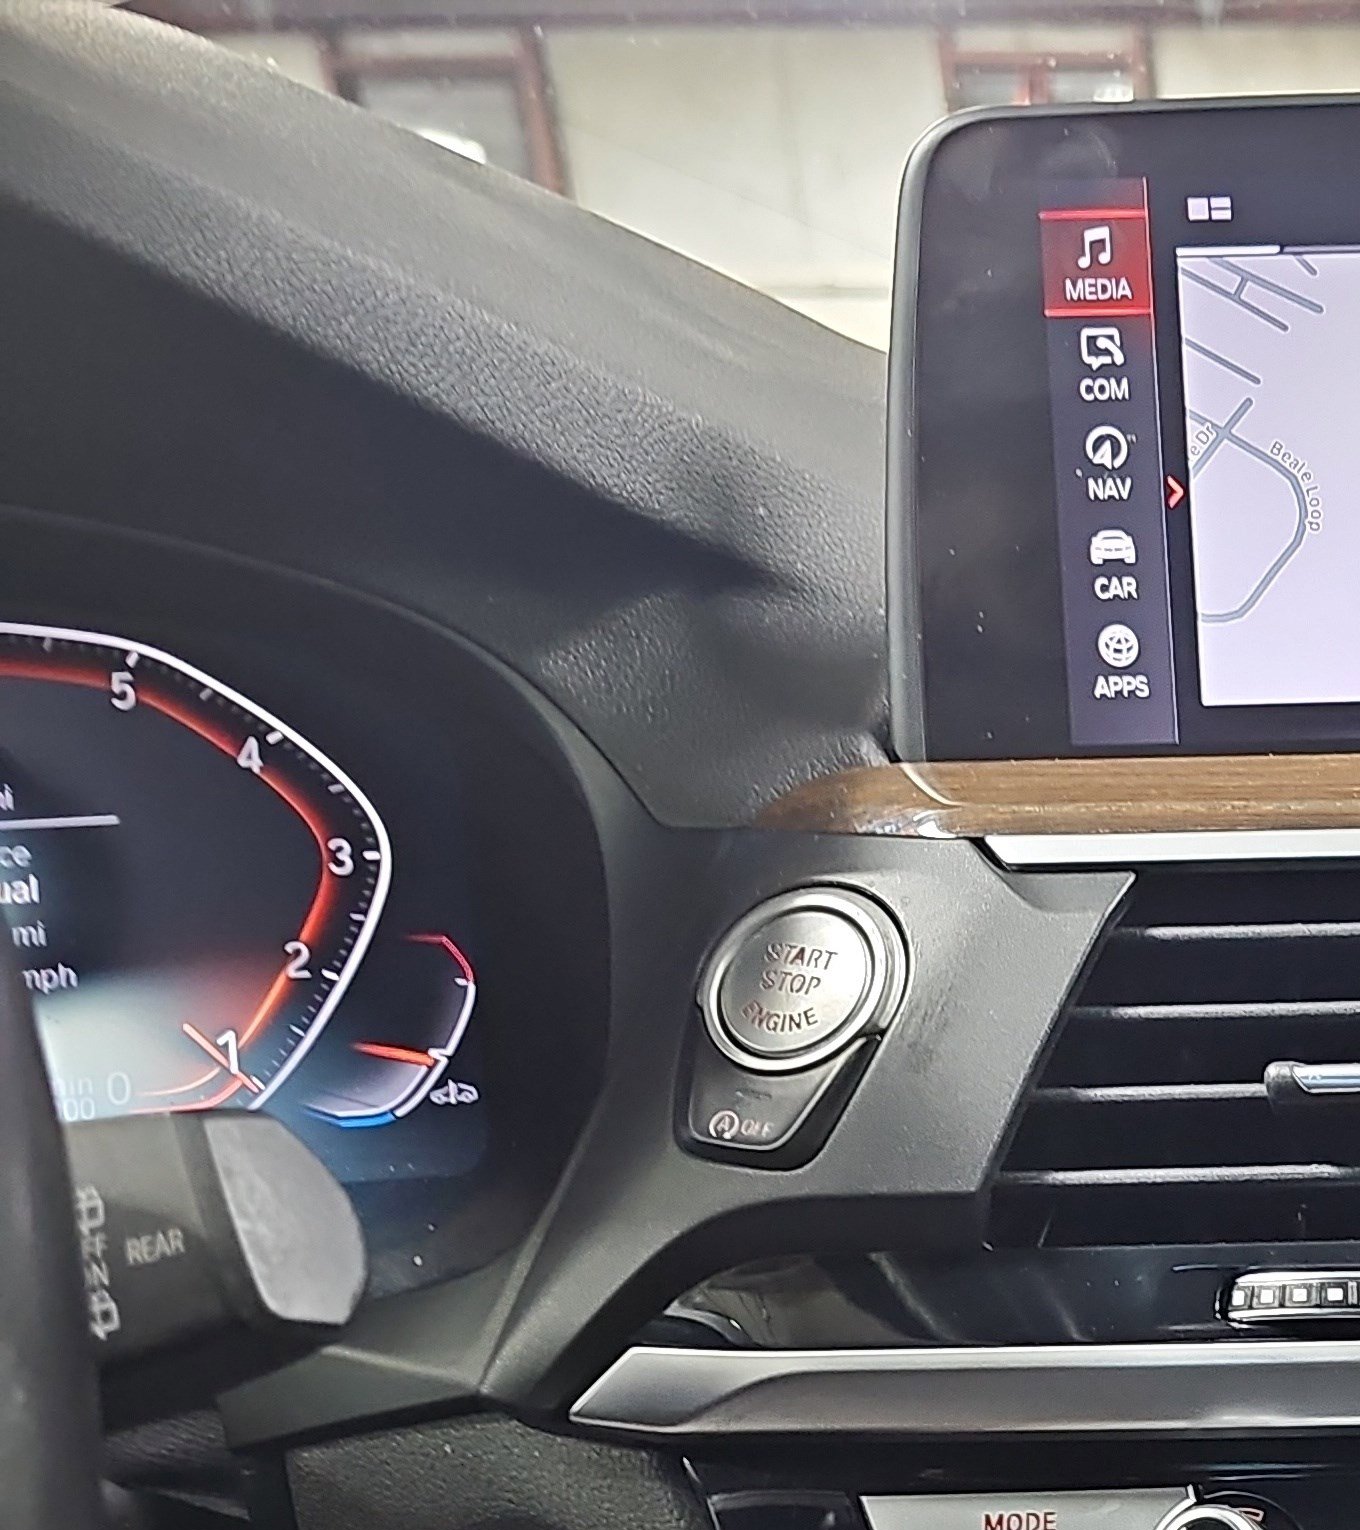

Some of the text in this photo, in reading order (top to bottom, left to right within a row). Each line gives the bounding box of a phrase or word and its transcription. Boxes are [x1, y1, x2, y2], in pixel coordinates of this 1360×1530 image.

[1065, 277, 1132, 301] MEDIA
[1080, 377, 1129, 401] COM
[1195, 424, 1214, 446] Dr
[1087, 477, 1132, 500] NAV
[1269, 440, 1322, 532] Beale Loop
[1094, 577, 1138, 600] CAR
[110, 671, 137, 711] 5
[1094, 675, 1150, 698] APPS
[236, 736, 264, 774] 4
[327, 838, 354, 876] 3
[12, 920, 47, 947] mi
[283, 941, 312, 979] 2
[766, 943, 838, 970] START
[760, 971, 821, 995] STOP
[742, 1000, 818, 1034] ENGINE
[216, 1030, 239, 1074] 1
[107, 1071, 131, 1106] 0
[126, 1228, 185, 1265] REAR
